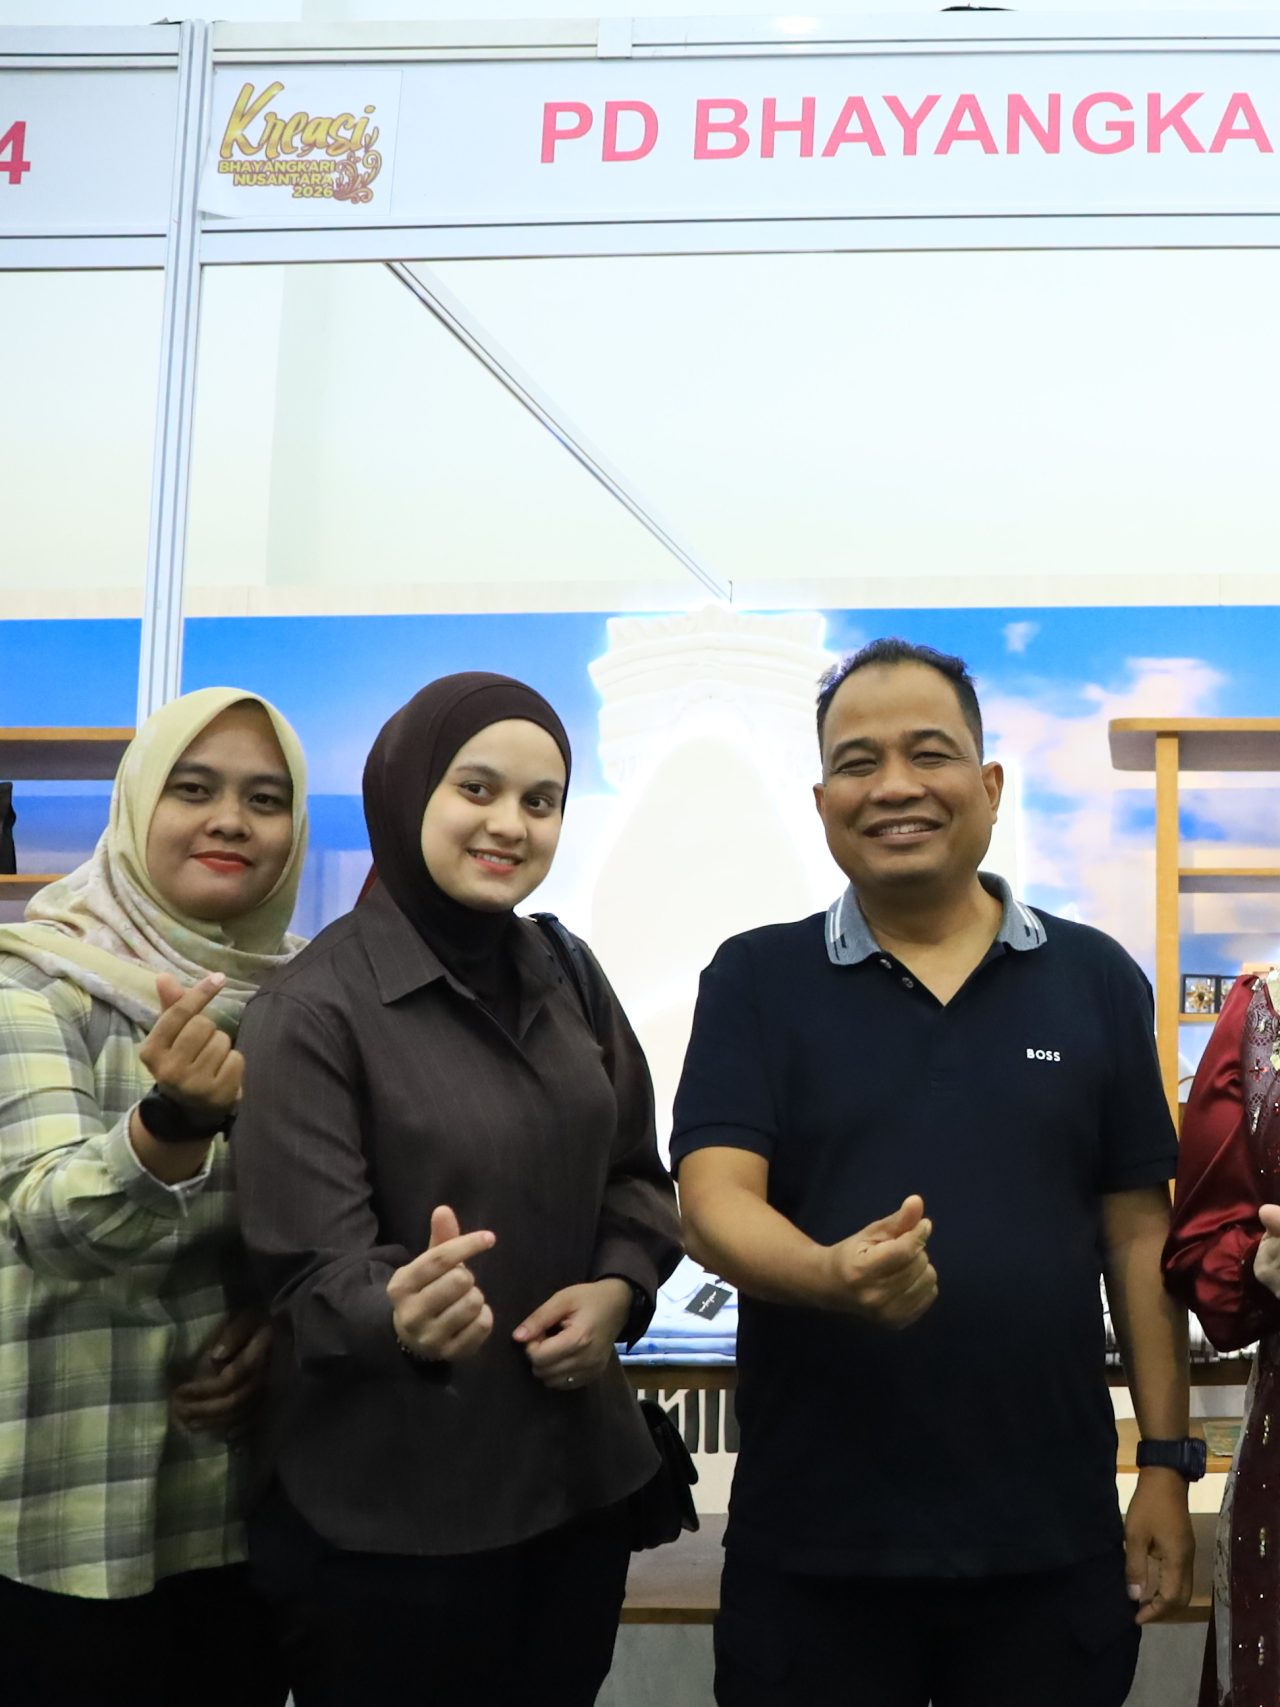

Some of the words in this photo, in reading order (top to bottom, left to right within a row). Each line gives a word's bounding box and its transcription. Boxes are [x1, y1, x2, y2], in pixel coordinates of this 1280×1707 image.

[219, 80, 377, 160] Kreasi
[541, 100, 659, 164] PD
[218, 160, 336, 174] BHAYANGKARI
[233, 173, 334, 186] NUSANTARA
[292, 185, 334, 198] 2026
[1026, 1048, 1061, 1062] BOSS
